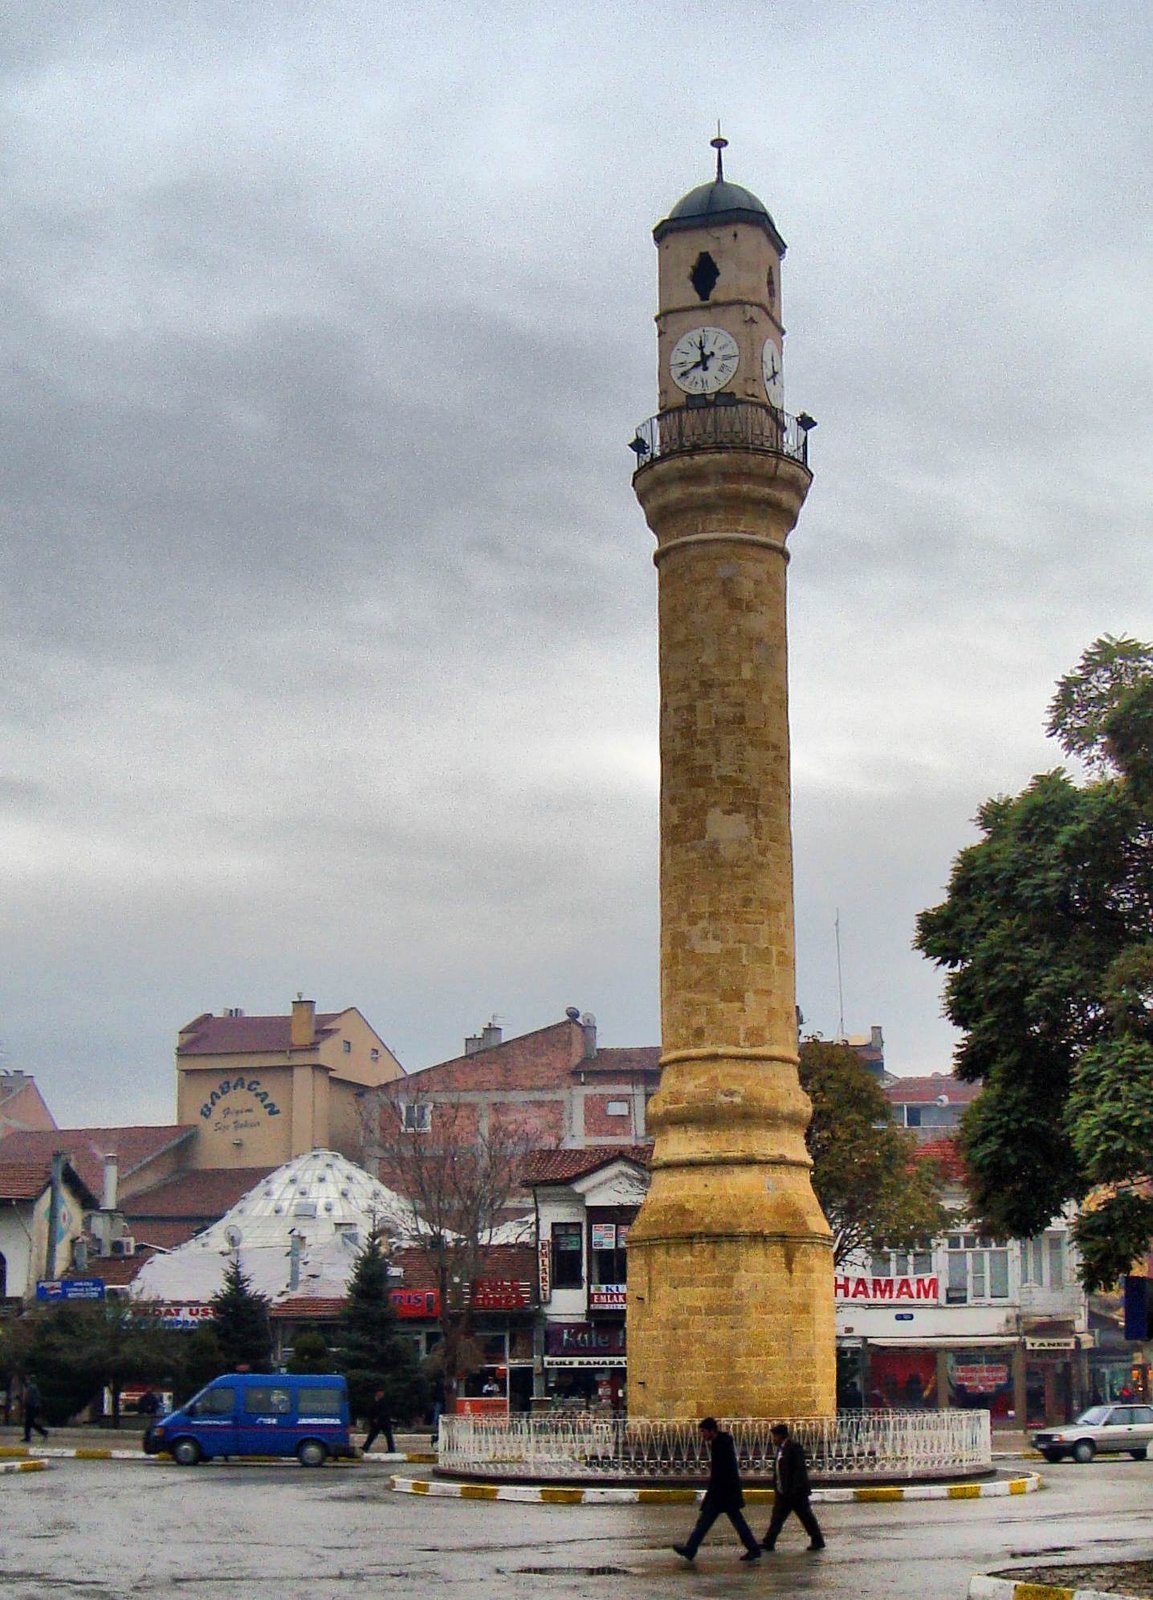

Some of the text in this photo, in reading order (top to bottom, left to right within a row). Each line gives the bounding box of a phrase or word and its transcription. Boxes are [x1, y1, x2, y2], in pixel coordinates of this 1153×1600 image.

[201, 1077, 280, 1119] BABACAN
[594, 1294, 625, 1303] EMLAK
[834, 1276, 938, 1299] HAMAM
